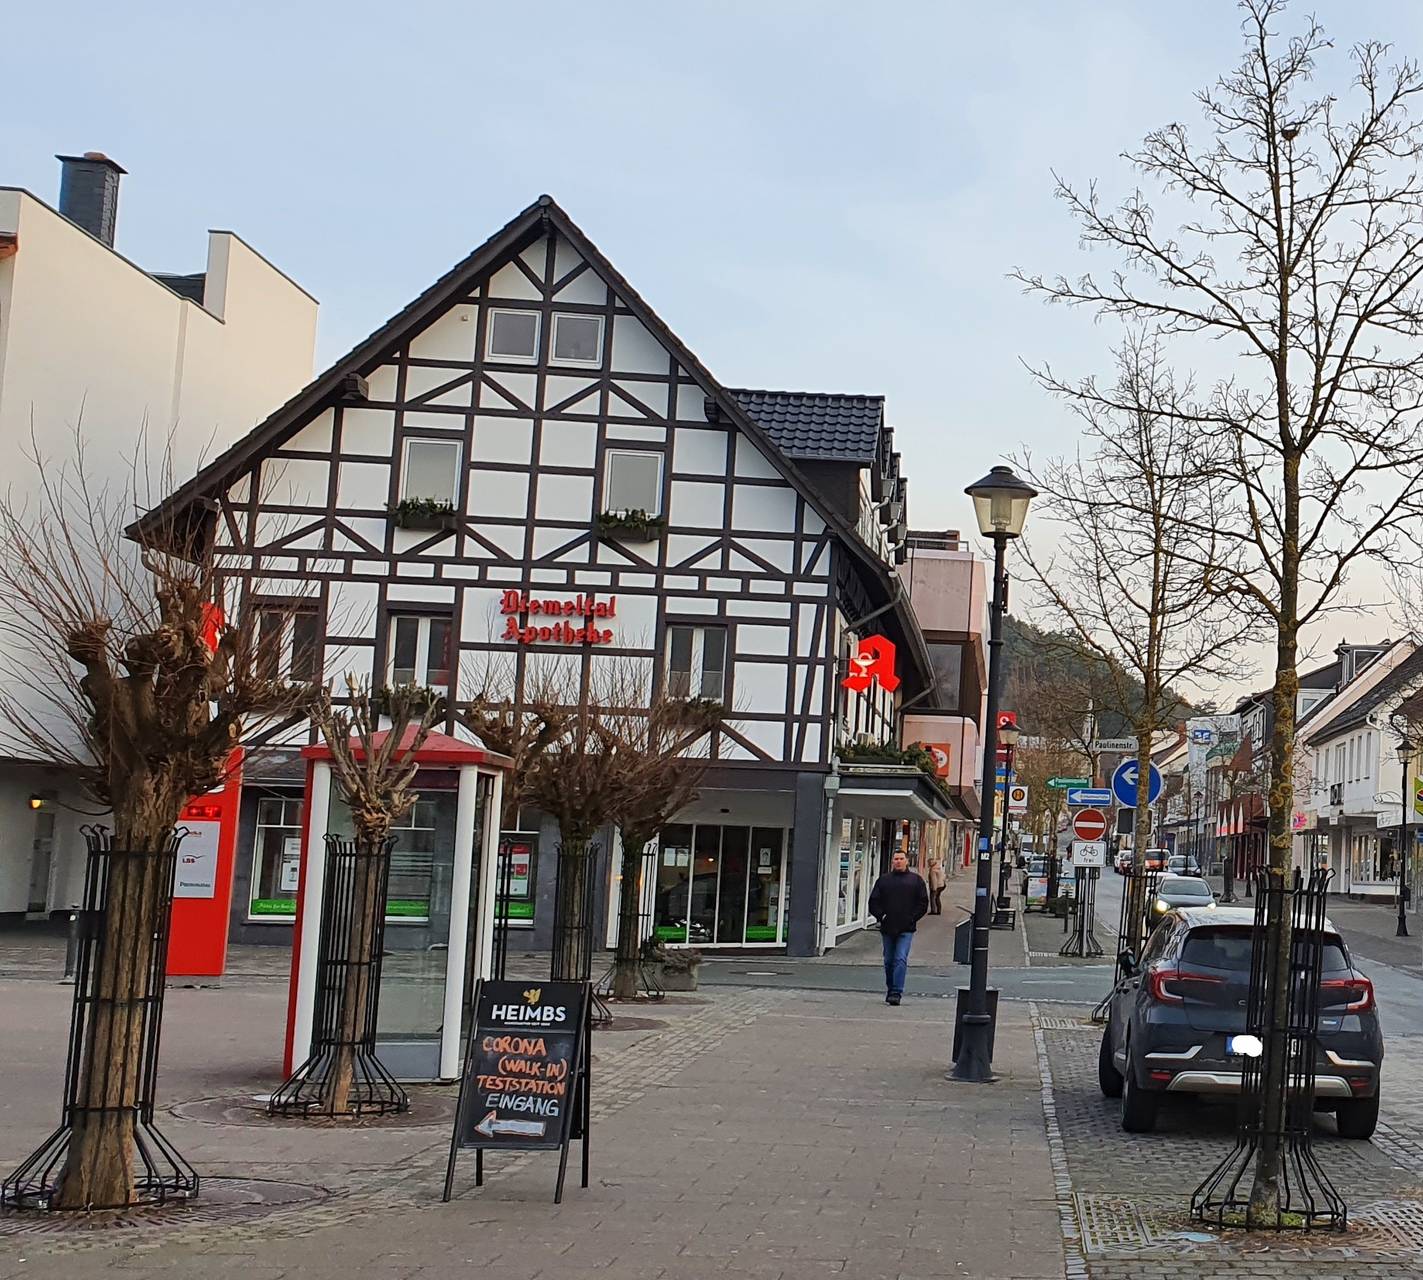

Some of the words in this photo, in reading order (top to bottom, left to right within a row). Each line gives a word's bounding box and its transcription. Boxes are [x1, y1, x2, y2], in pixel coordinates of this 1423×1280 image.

[501, 616, 613, 645] Apotheke
[491, 1004, 566, 1022] HEIMBS
[482, 1036, 547, 1056] CORONA
[498, 1056, 567, 1081] (WALK-IN)
[476, 1074, 566, 1095] TESTSTATION
[485, 1093, 560, 1116] EINGANG
